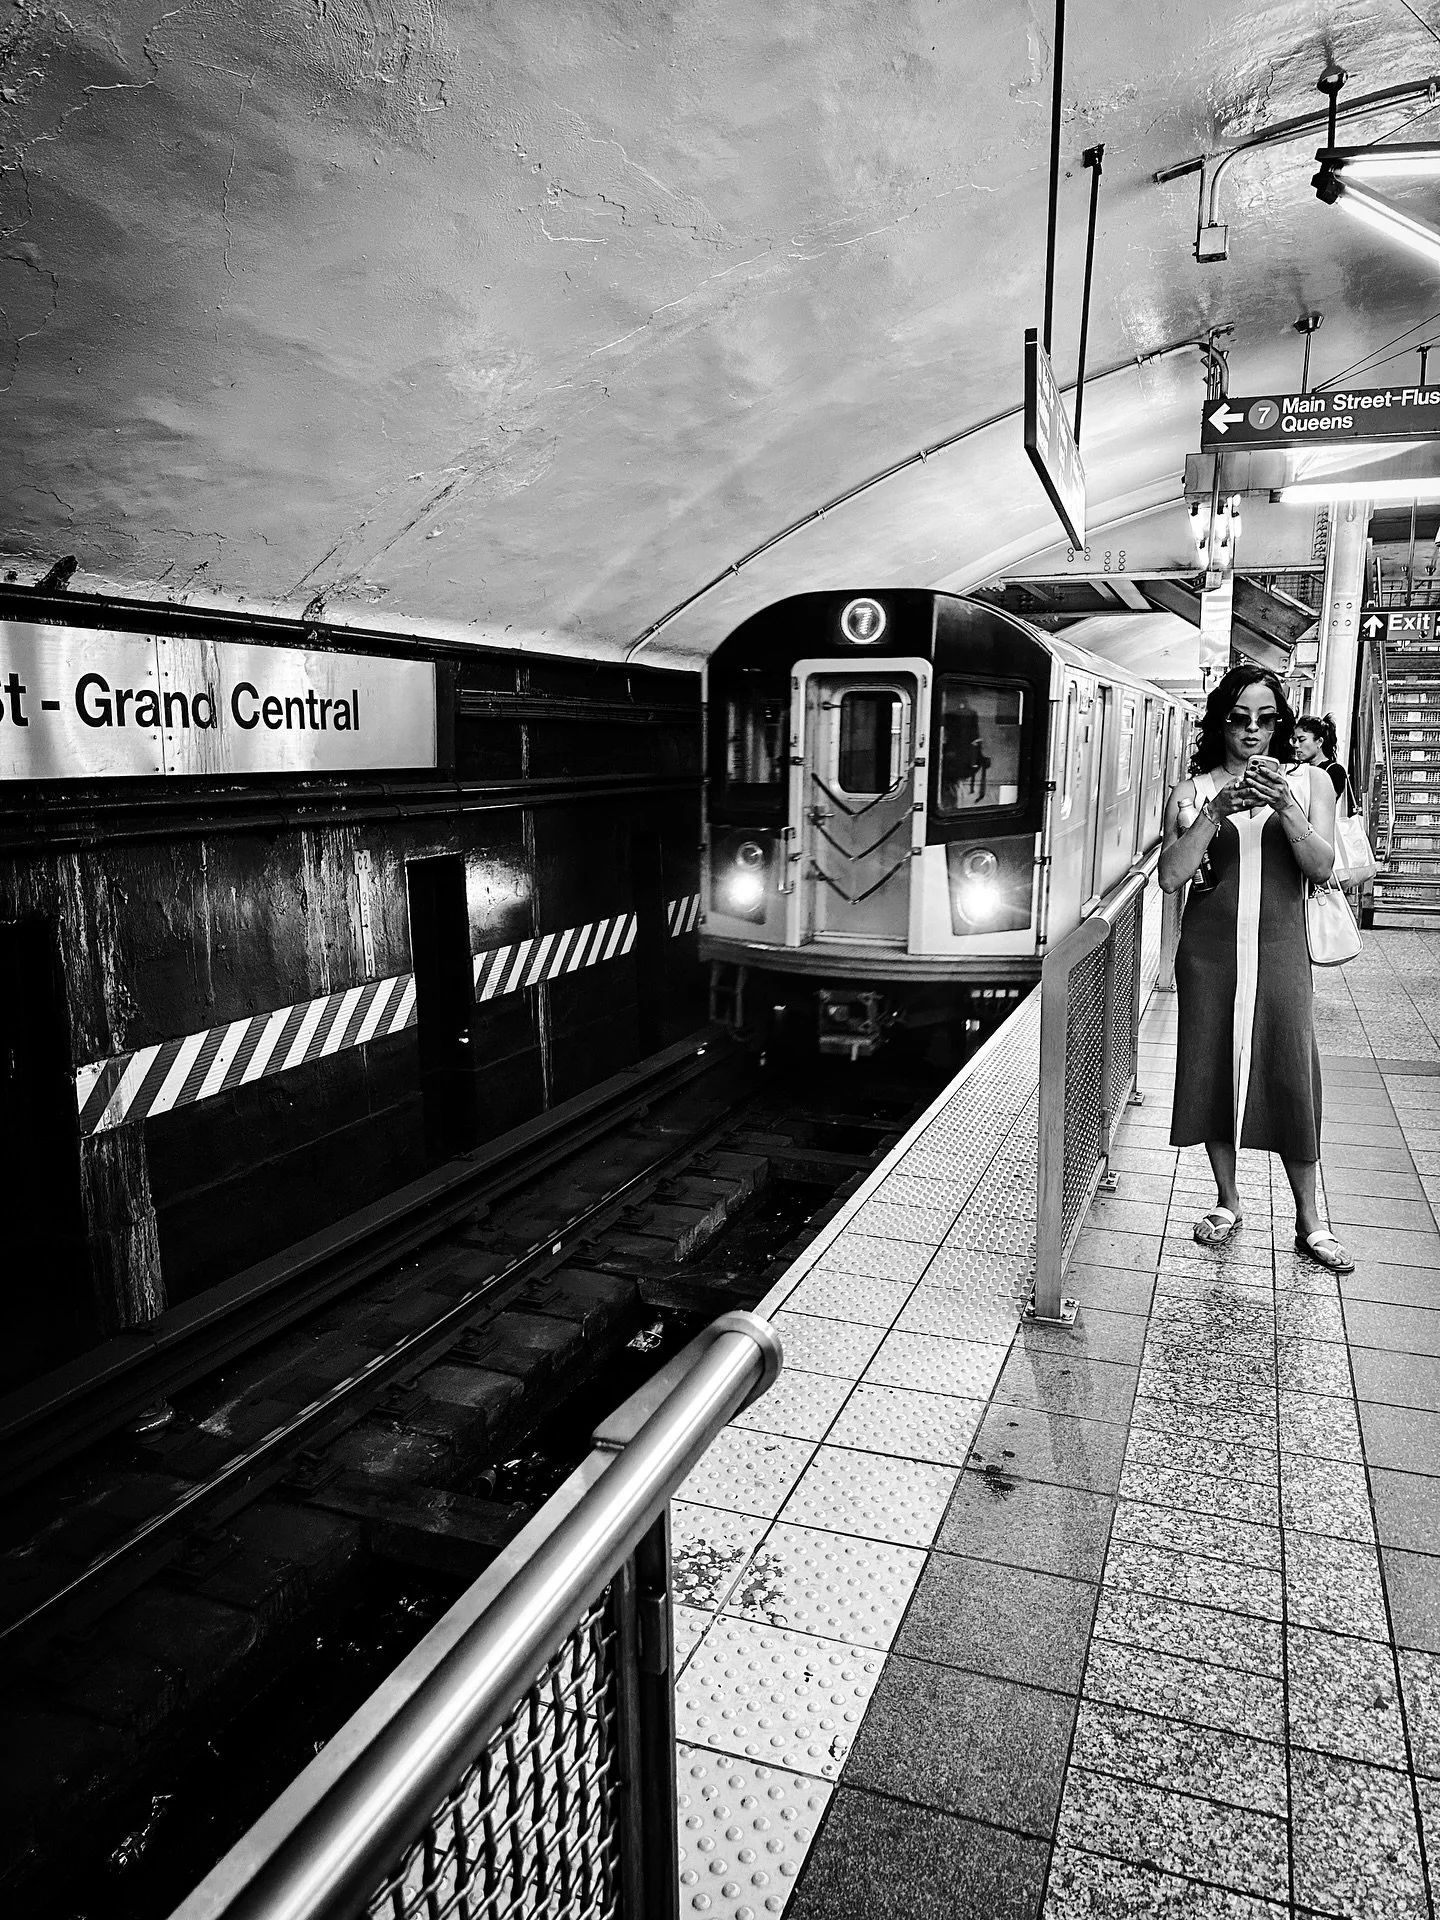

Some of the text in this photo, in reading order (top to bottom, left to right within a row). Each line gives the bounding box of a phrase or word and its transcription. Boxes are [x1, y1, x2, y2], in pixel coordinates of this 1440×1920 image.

[1282, 397, 1326, 414] Main
[1257, 406, 1271, 424] 7
[1281, 415, 1354, 433] Queens
[855, 607, 873, 635] 7
[1388, 613, 1432, 631] Exit
[0, 672, 29, 727] t
[75, 672, 218, 730] Grand
[231, 681, 360, 731] Central
